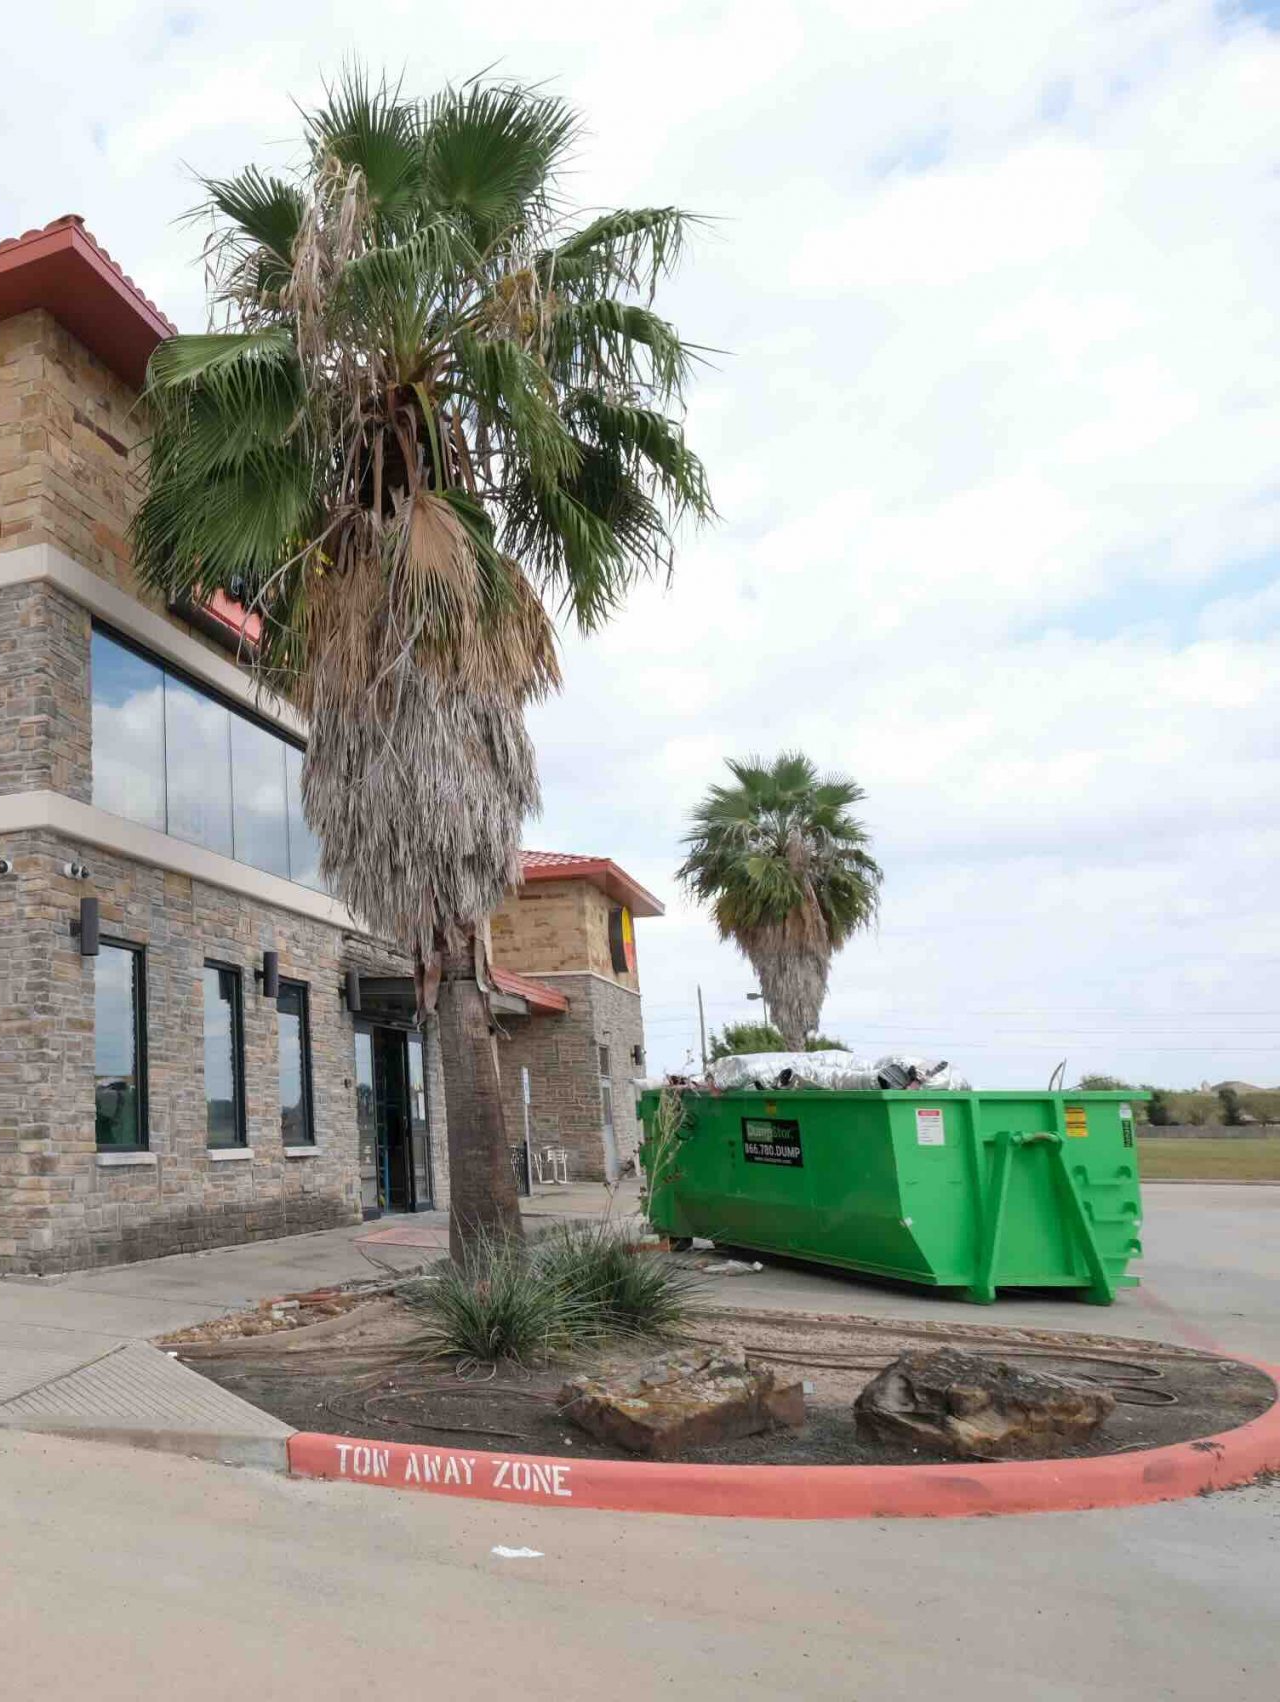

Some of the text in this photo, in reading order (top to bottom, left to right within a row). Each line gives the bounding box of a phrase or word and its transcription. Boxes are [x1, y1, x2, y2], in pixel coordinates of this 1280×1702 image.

[336, 1443, 573, 1497] TOW AWAY ZONE
